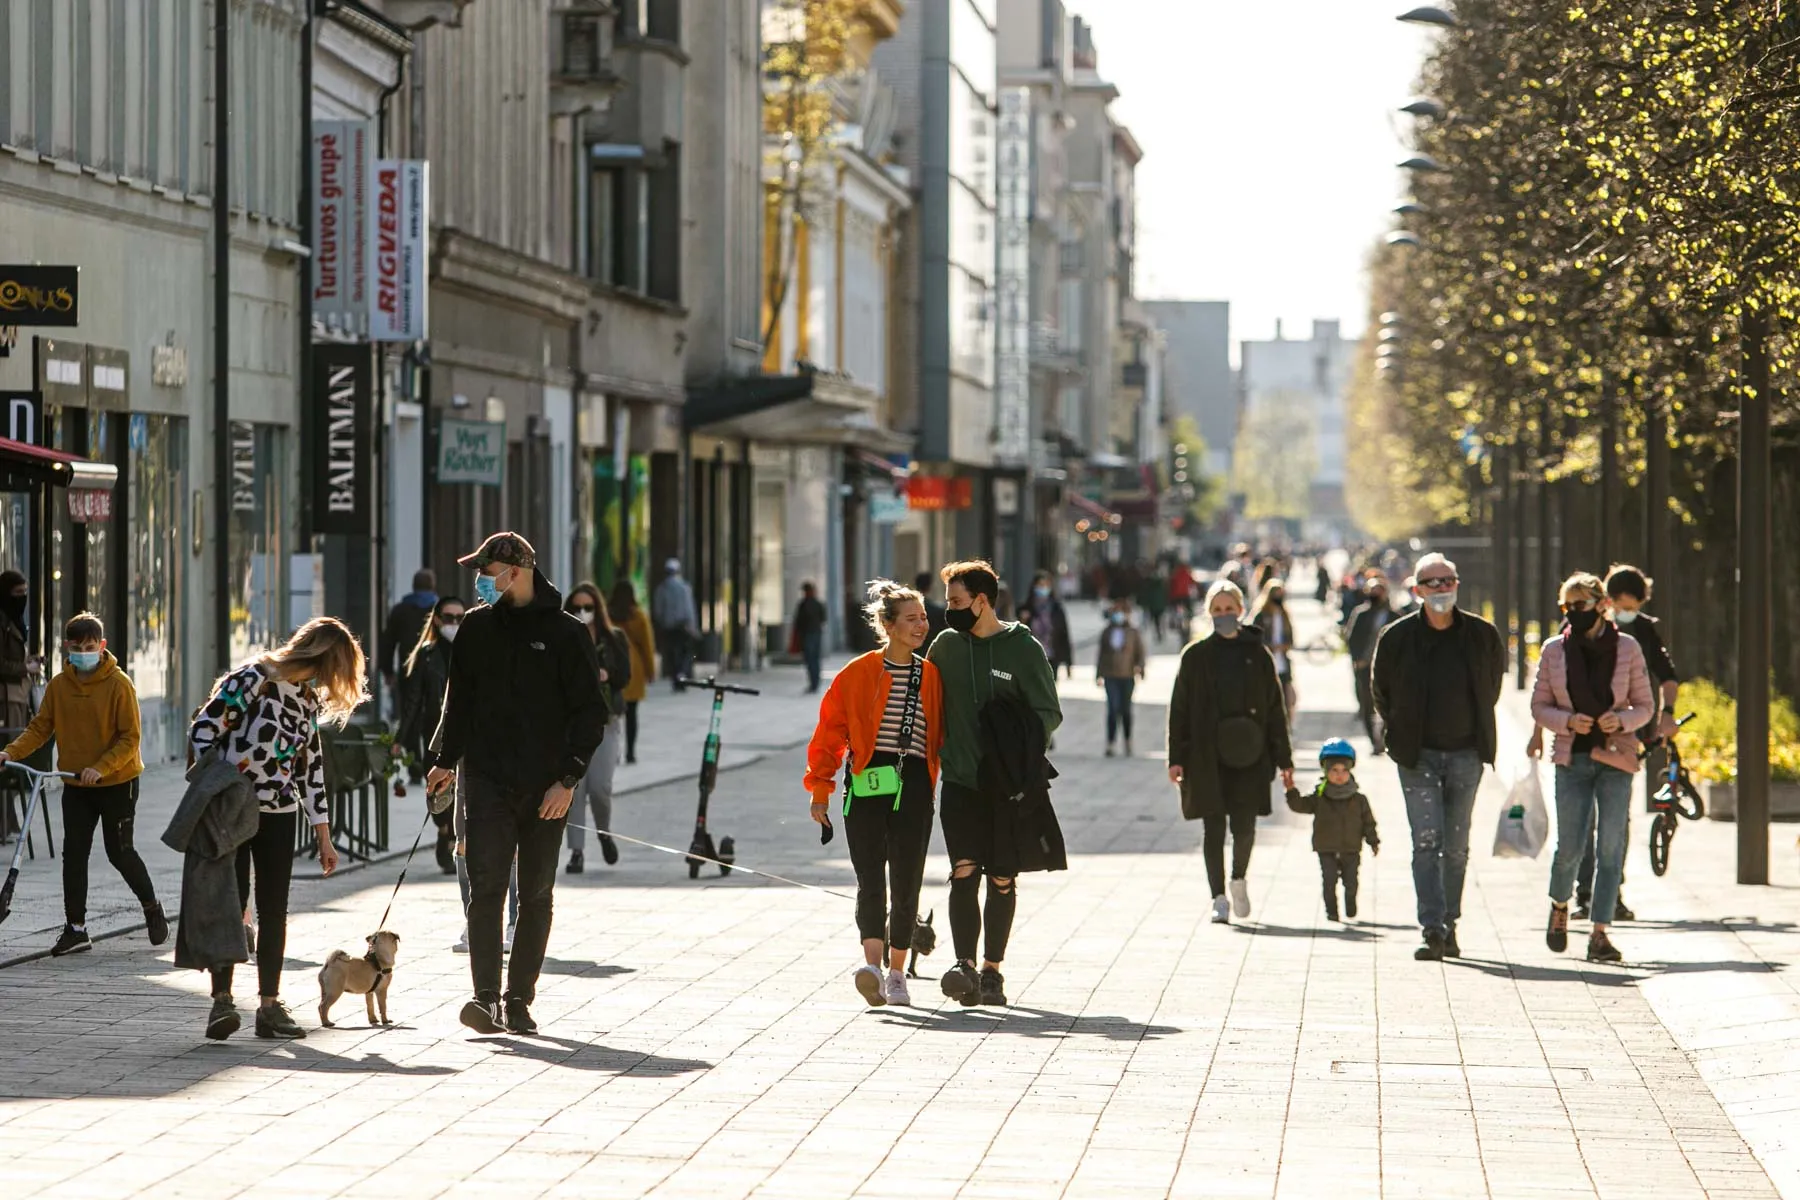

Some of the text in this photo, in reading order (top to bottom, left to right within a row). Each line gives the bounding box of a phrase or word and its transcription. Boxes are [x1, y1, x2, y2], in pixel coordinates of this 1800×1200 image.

[314, 204, 337, 299] Turtuvos
[377, 169, 397, 313] RIGVEDA
[328, 363, 355, 512] BALTMAN
[911, 657, 922, 686] ARC
